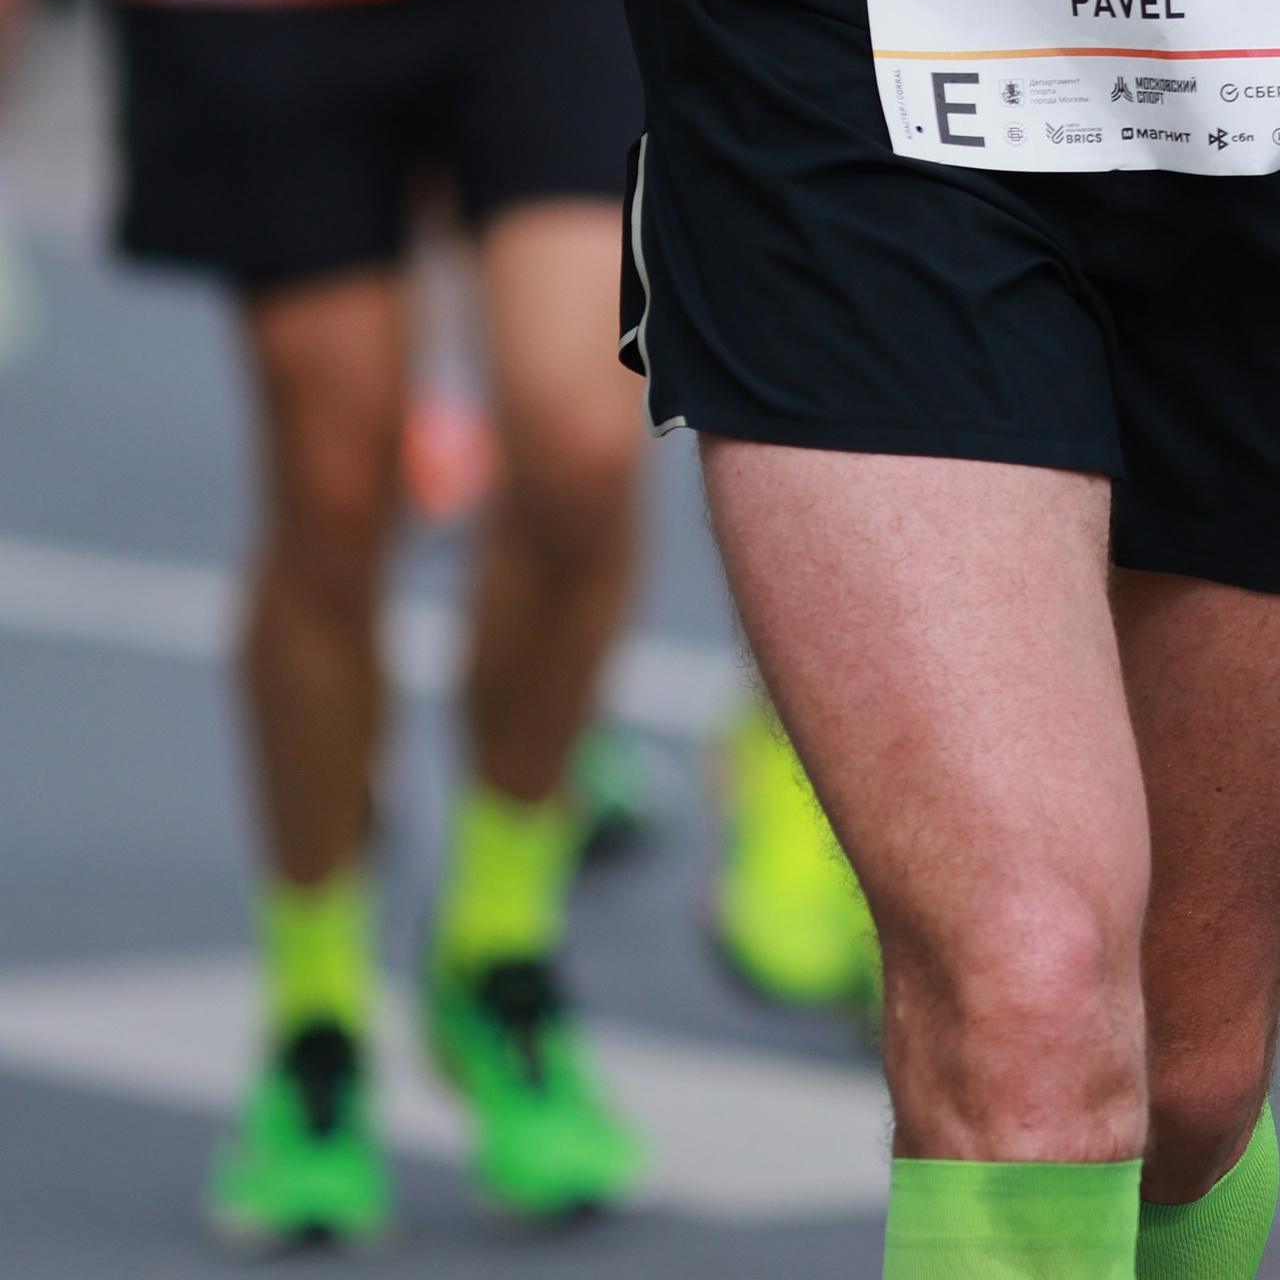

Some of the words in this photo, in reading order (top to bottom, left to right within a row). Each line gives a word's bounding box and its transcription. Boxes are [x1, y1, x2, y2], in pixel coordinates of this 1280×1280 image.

[893, 68, 904, 100] CORRAL
[1135, 76, 1197, 93] МОСКОВСКИЙ
[1137, 91, 1165, 105] СПОРТ
[930, 72, 986, 148] E
[1066, 133, 1103, 144] BRICS
